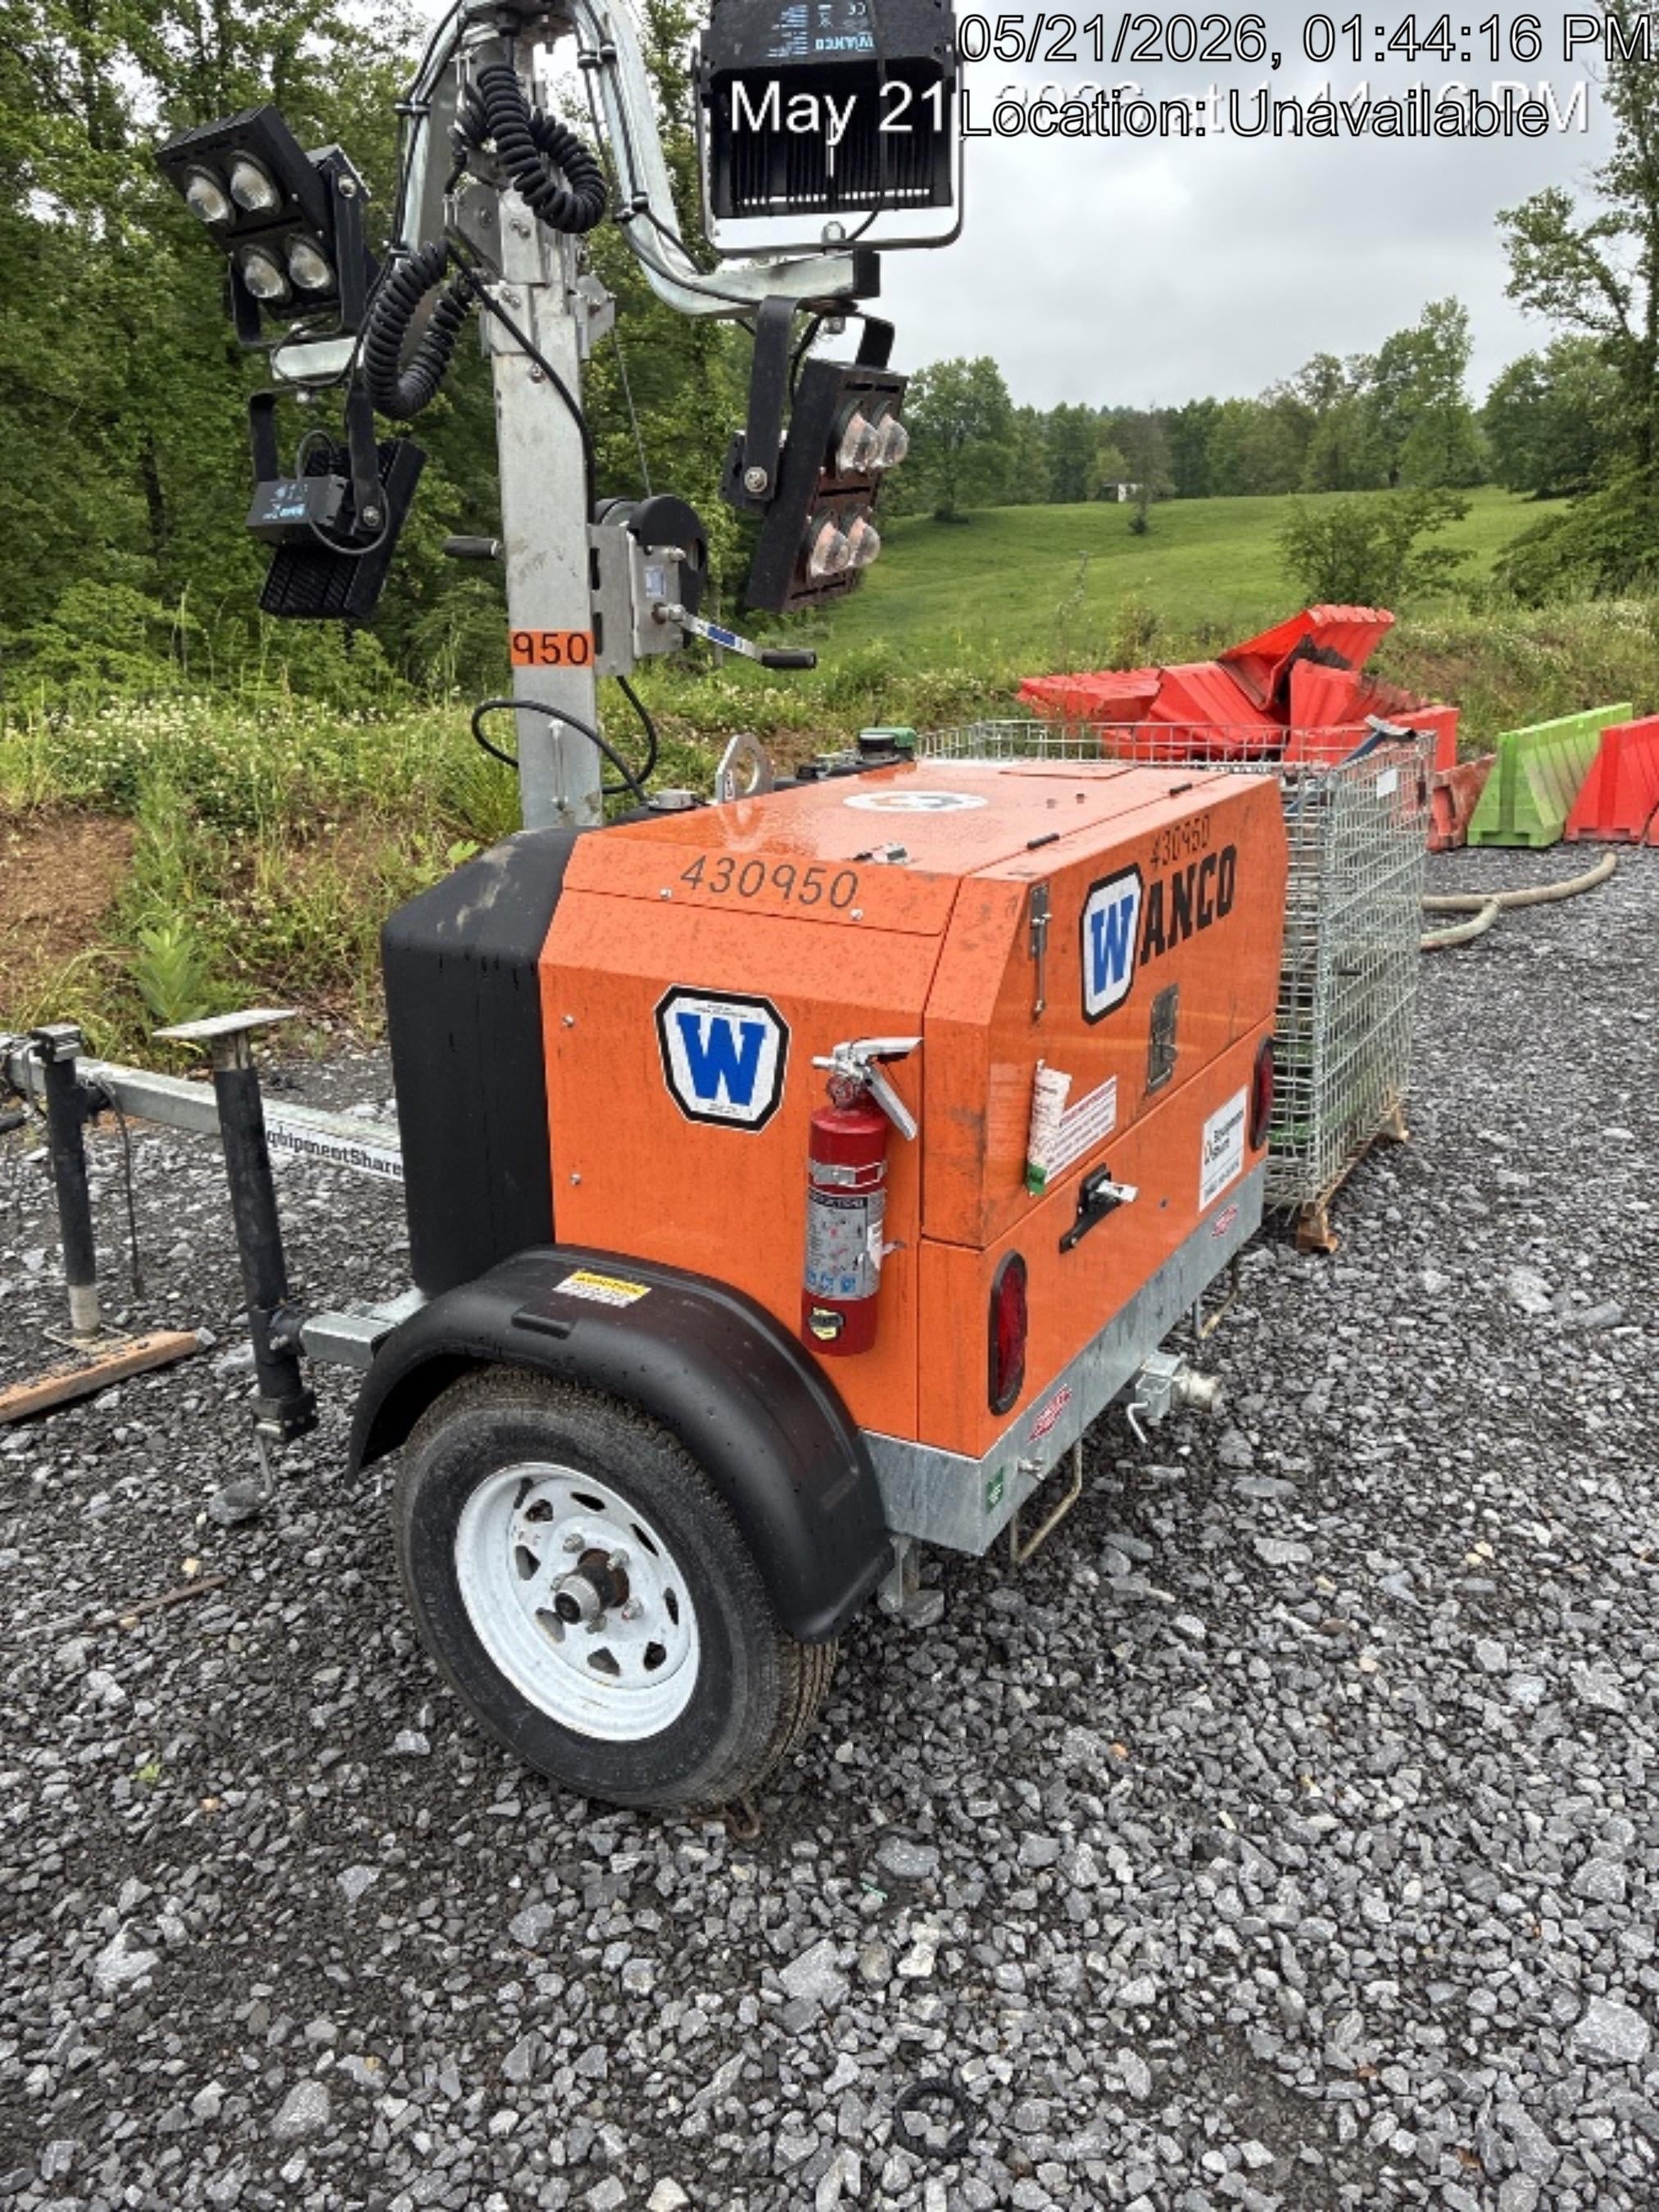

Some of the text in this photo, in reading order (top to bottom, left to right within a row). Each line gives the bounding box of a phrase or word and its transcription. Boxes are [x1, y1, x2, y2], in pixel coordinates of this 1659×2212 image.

[512, 632, 588, 666] 950
[1150, 814, 1211, 871] 430950
[680, 854, 859, 909] 430950
[676, 1012, 767, 1107] W
[266, 1127, 402, 1176] quipmentShare
